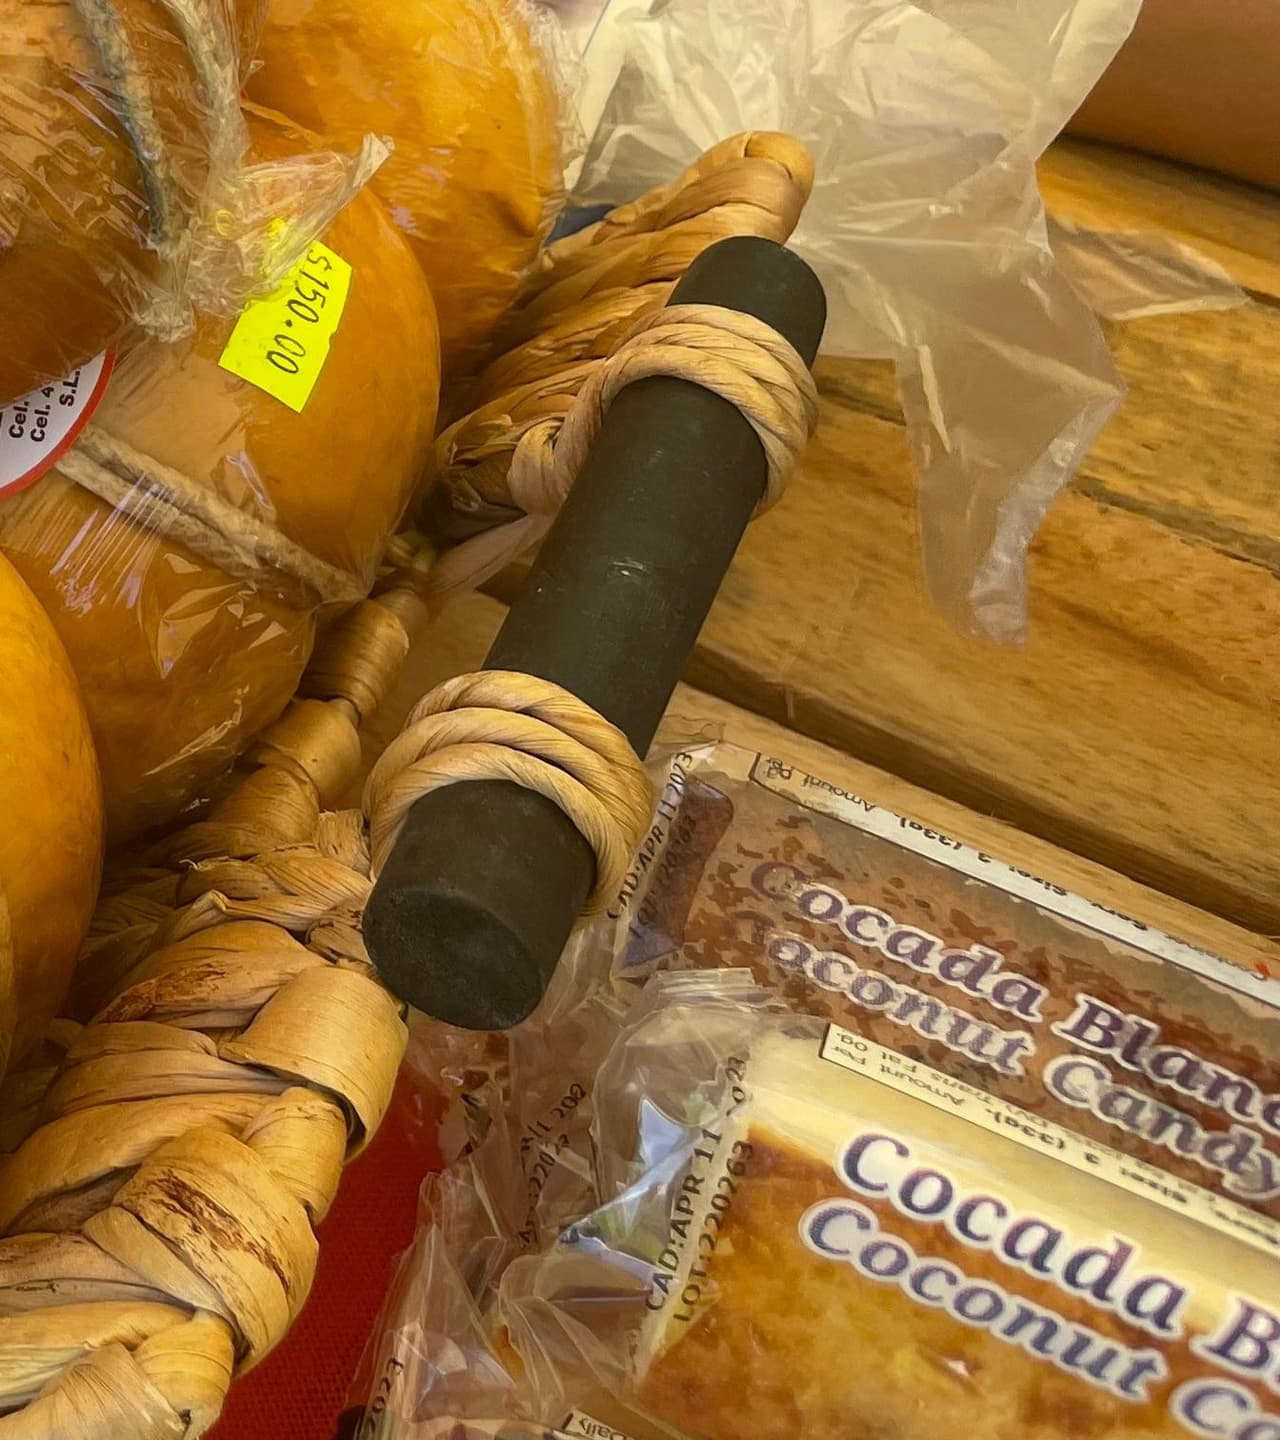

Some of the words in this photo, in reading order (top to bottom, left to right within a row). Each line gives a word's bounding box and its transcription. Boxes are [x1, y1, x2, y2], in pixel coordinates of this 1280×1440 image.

[267, 249, 333, 374] $150.00
[31, 405, 51, 442] Cel.
[749, 926, 1029, 1073] oconut
[750, 861, 1044, 1018] Cocada
[646, 1174, 704, 1311] CAD:APR
[694, 1128, 722, 1162] 11
[842, 1133, 1187, 1332] Cocada
[809, 1206, 1161, 1395] Coconut
